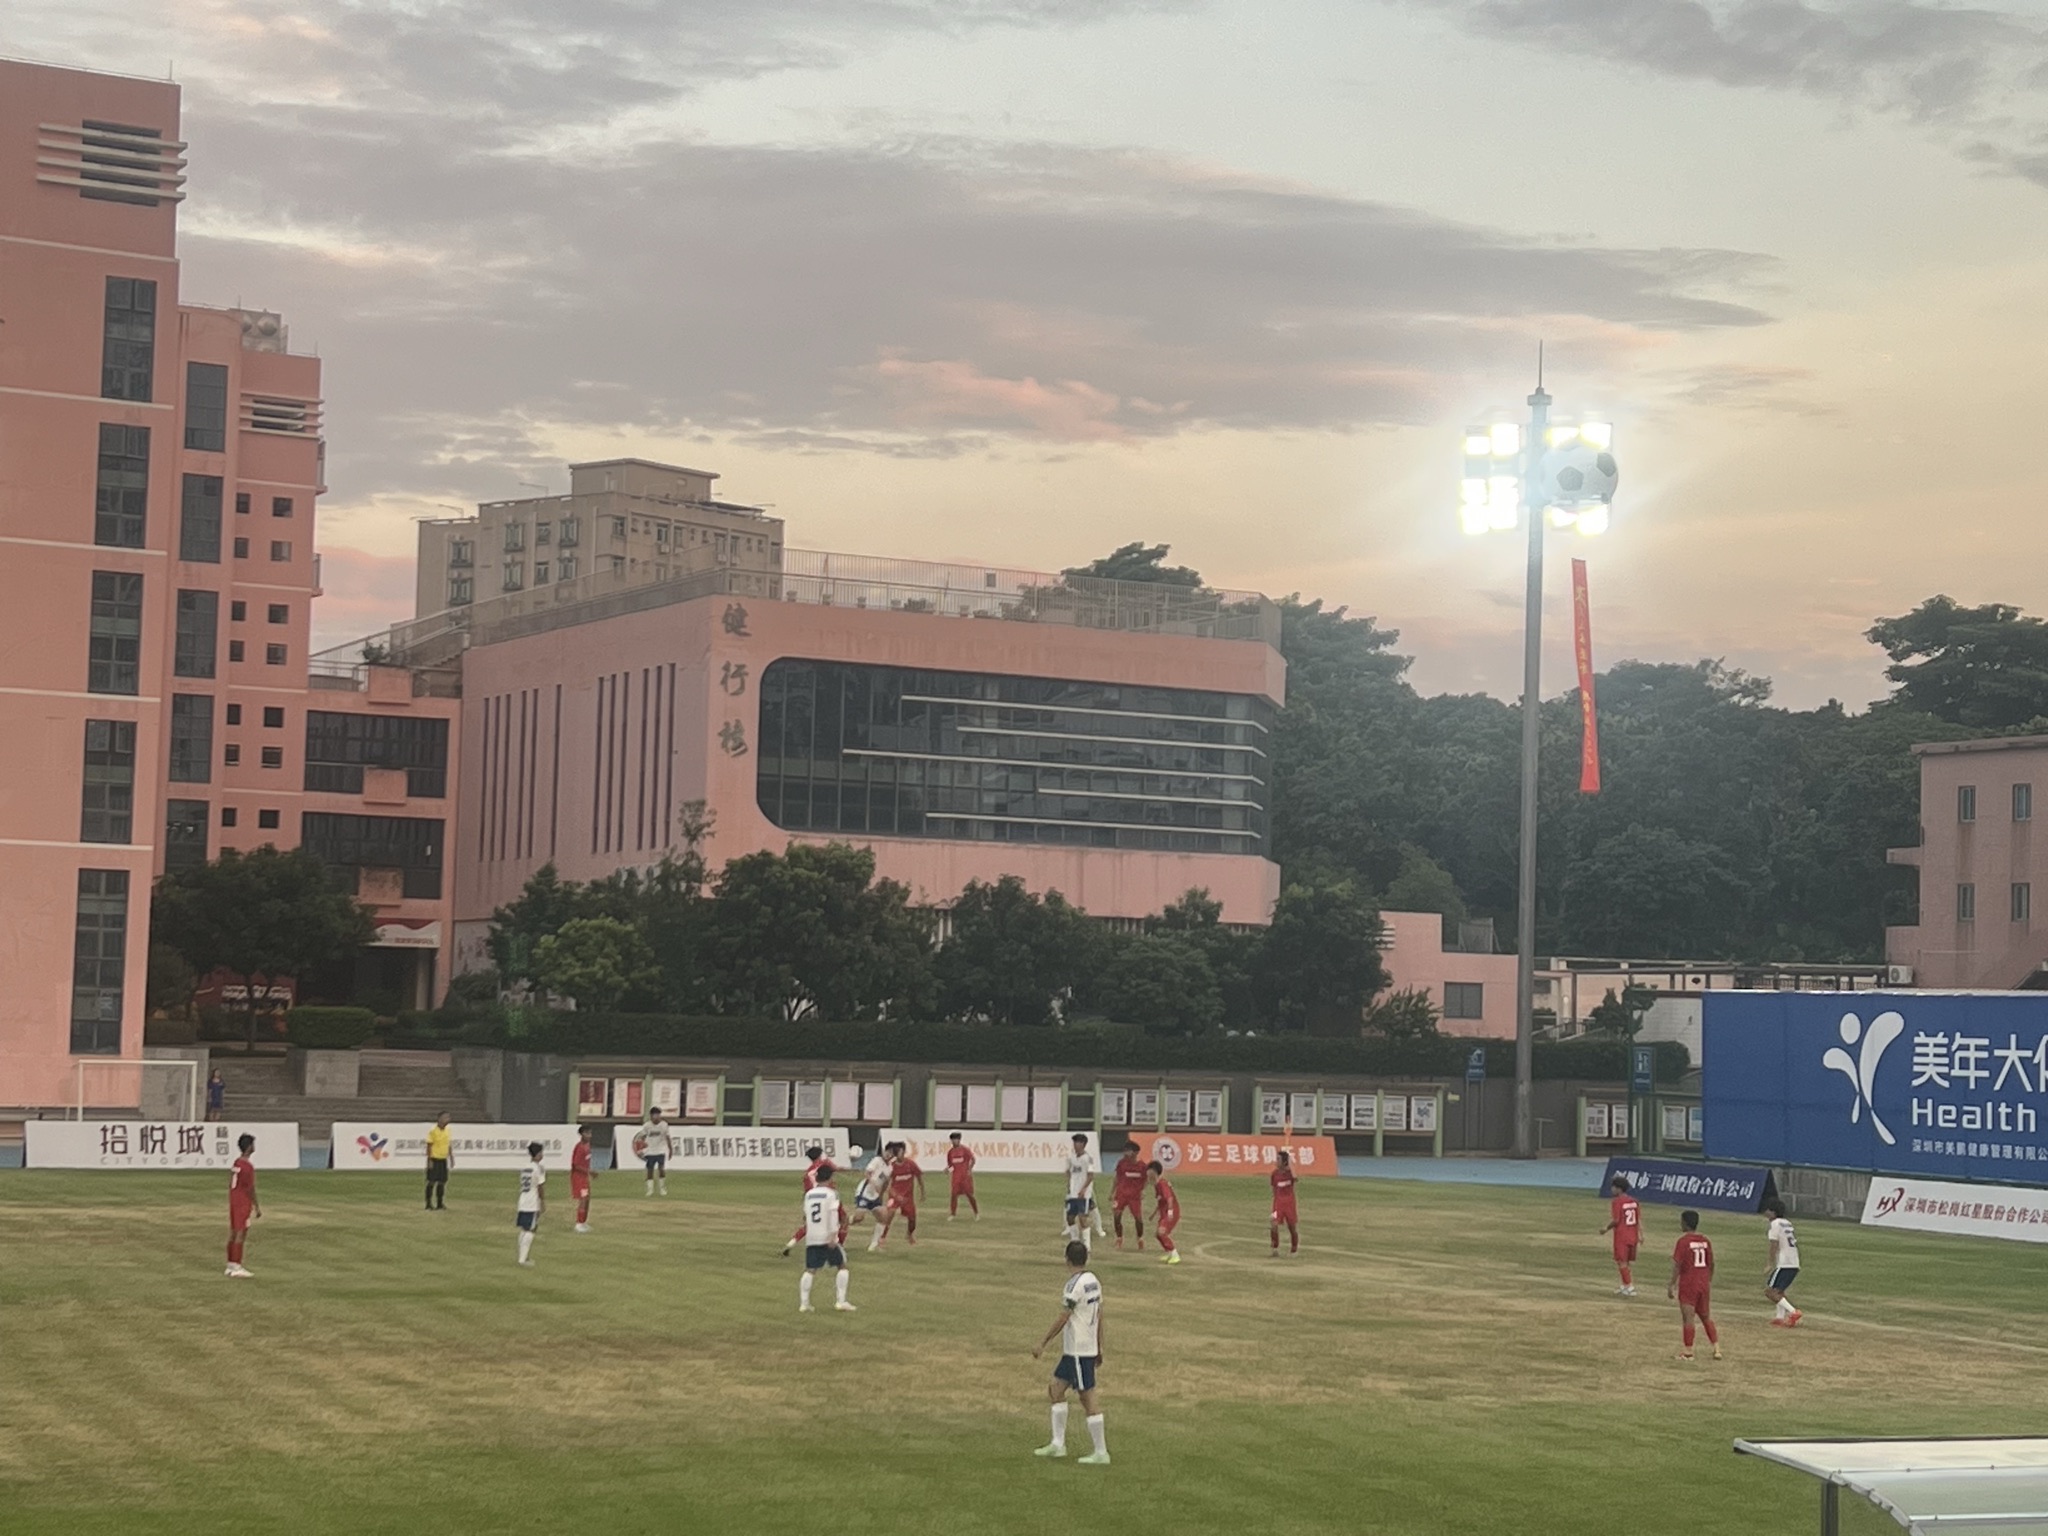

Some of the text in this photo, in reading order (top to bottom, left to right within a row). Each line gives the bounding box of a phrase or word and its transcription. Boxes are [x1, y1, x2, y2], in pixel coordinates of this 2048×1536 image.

[1912, 1097, 2036, 1132] Health
[100, 1124, 205, 1155] 拾悦城
[810, 1201, 822, 1224] 2
